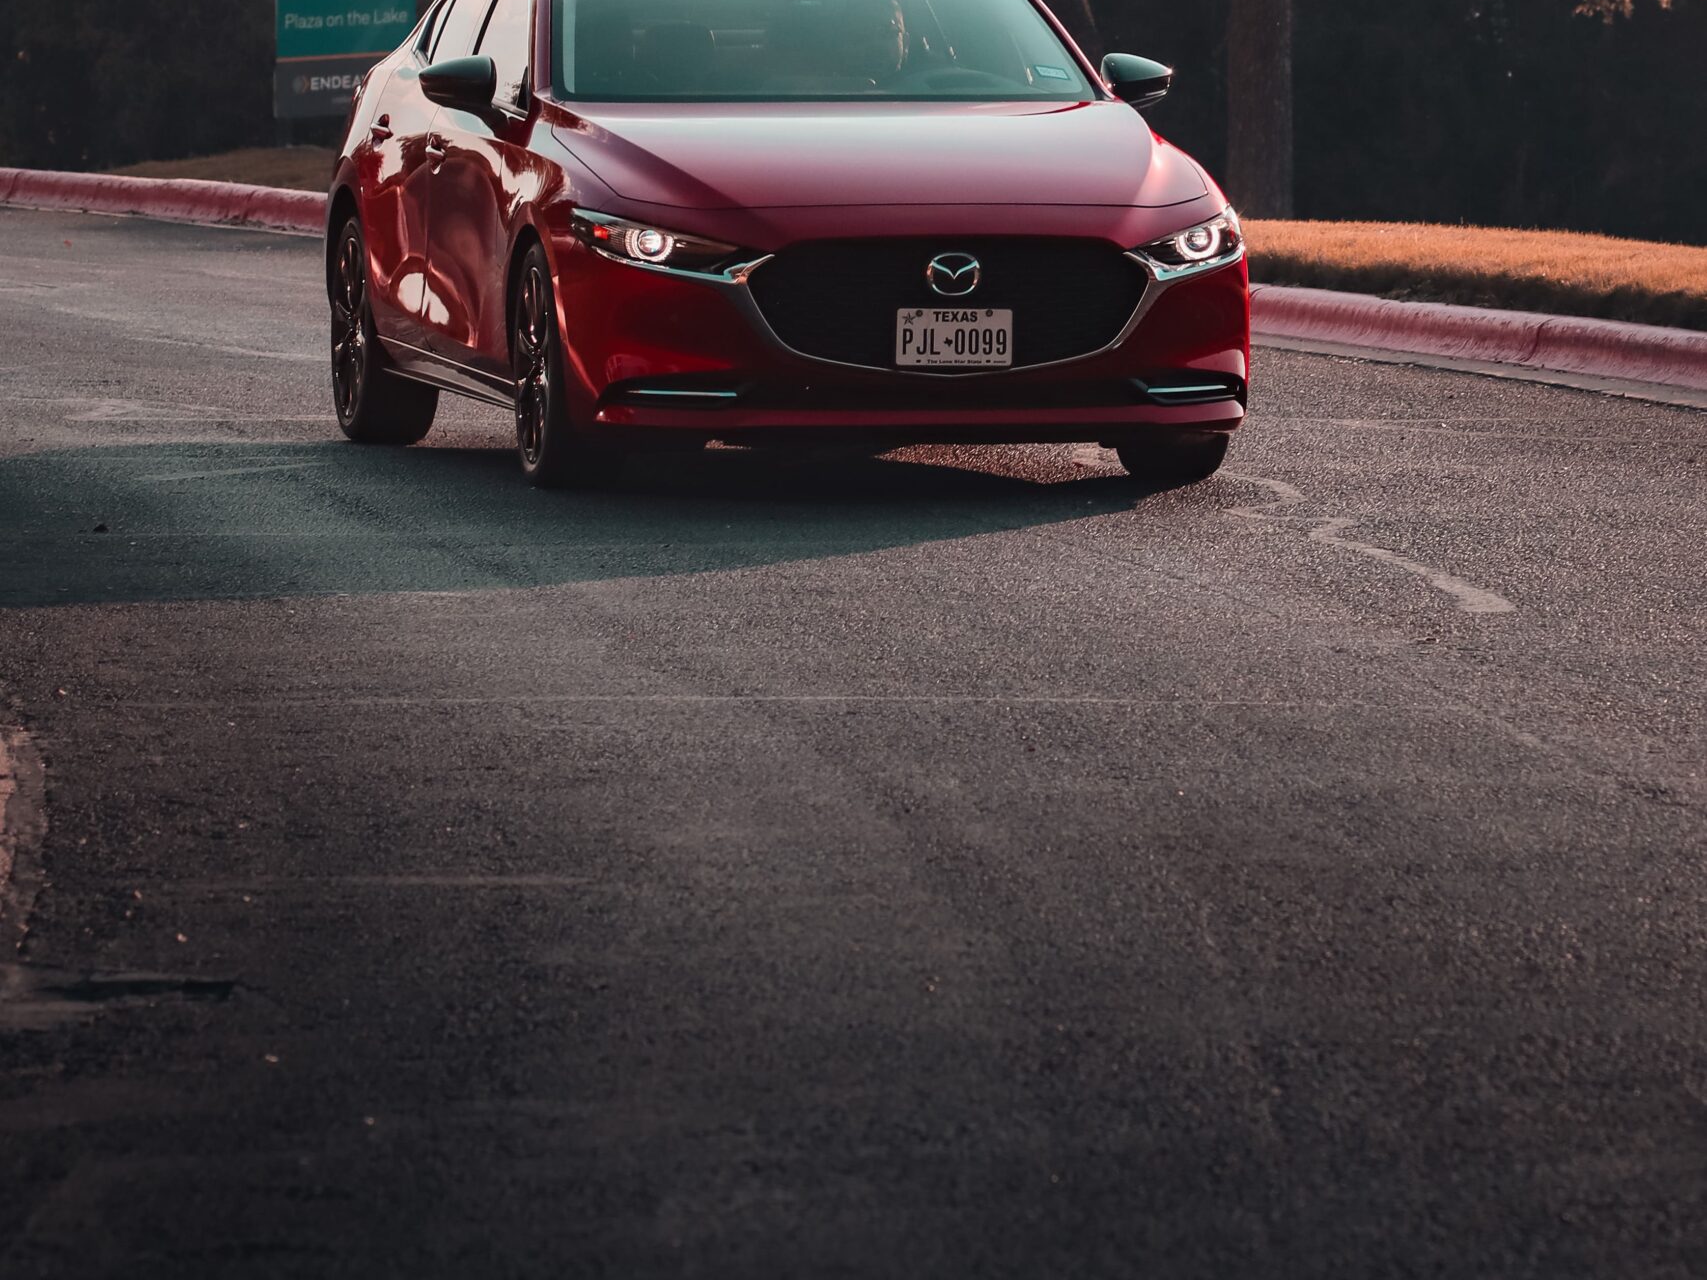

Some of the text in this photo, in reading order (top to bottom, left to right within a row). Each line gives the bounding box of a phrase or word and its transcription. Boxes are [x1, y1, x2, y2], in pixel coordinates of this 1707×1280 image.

[284, 8, 408, 29] Plaza on the Lake
[310, 75, 365, 91] ENDEA
[933, 311, 978, 323] TEXAS
[902, 328, 1007, 355] PJL 0099
